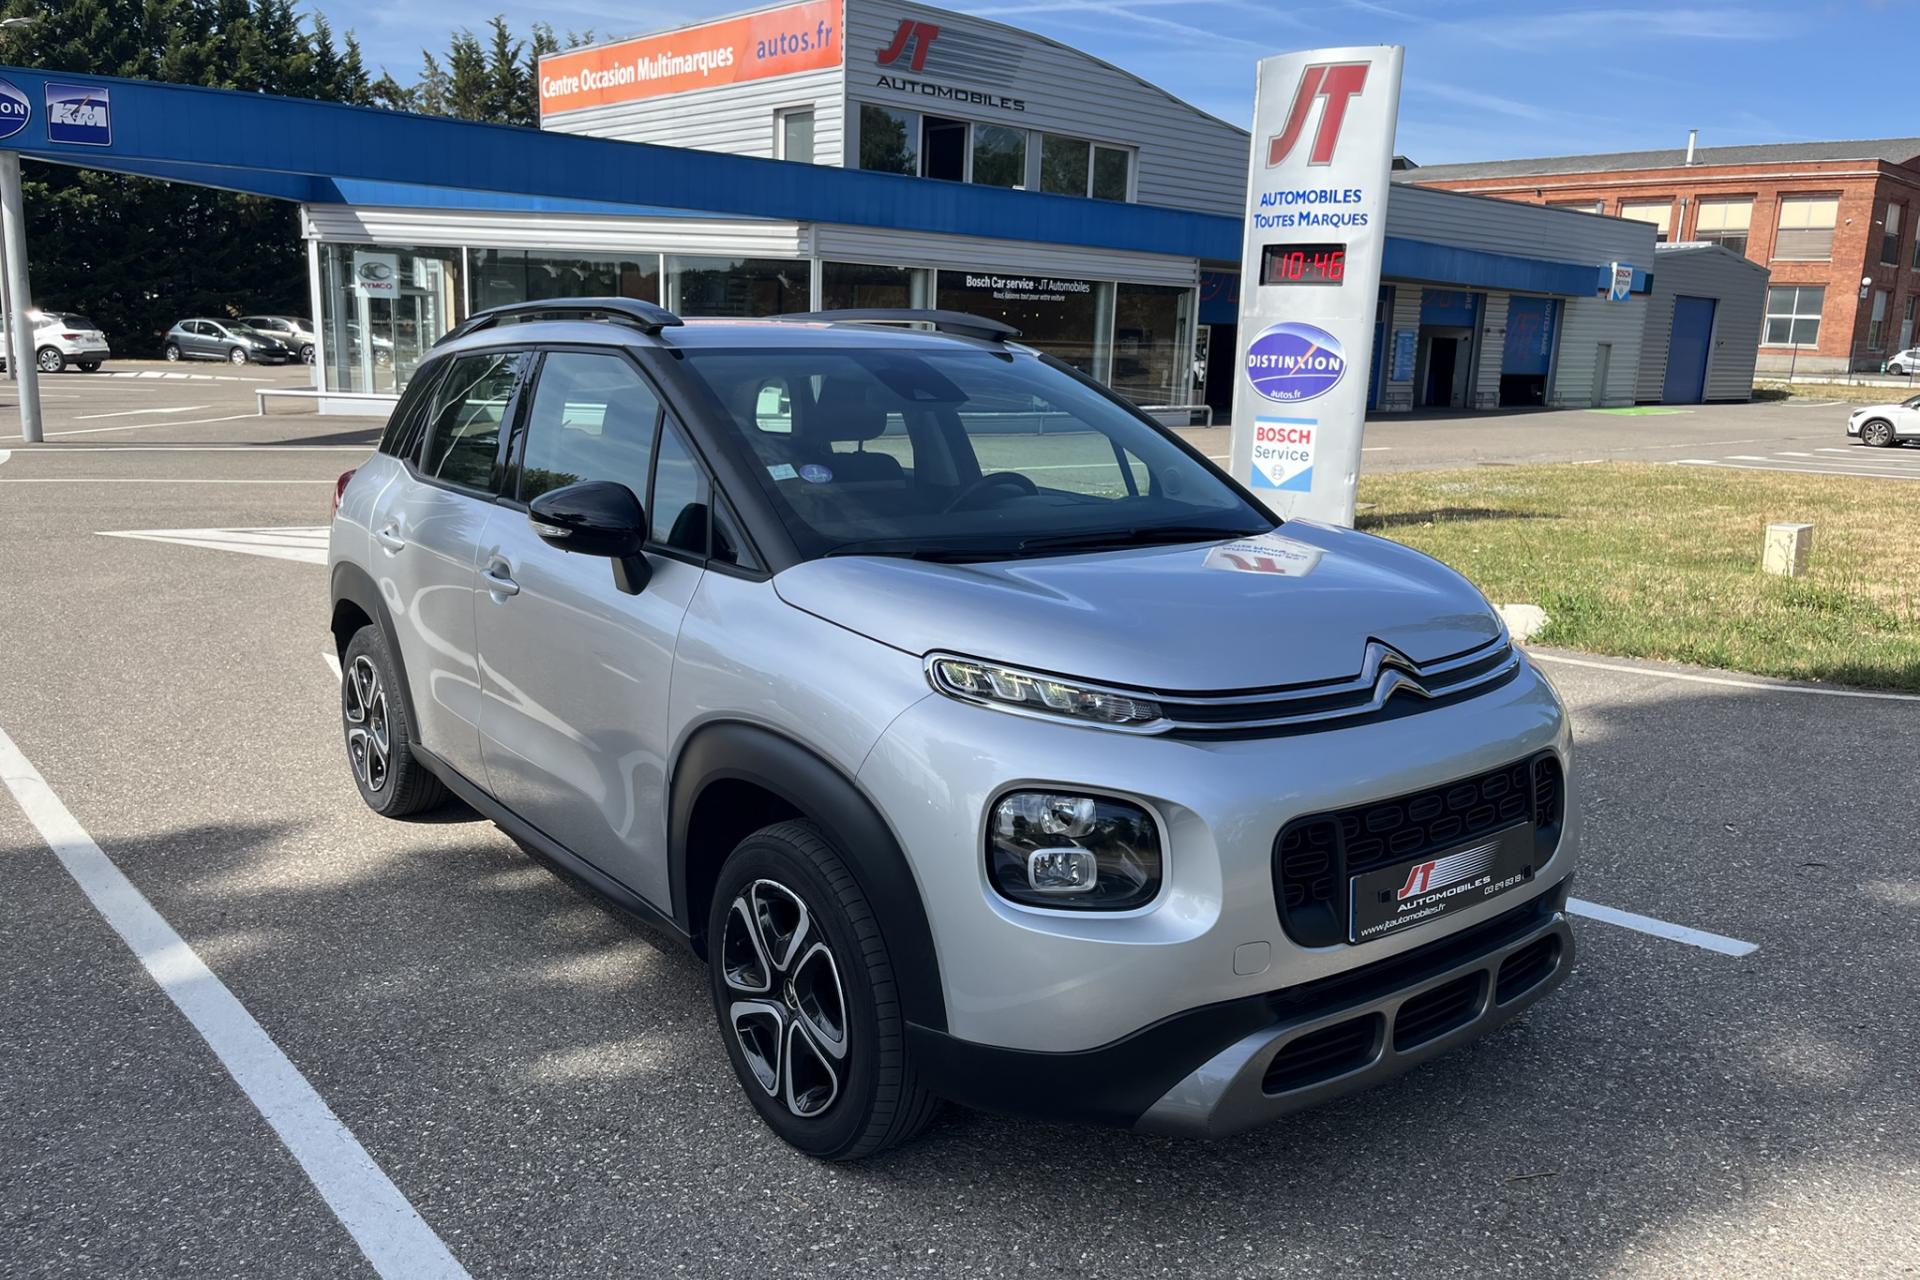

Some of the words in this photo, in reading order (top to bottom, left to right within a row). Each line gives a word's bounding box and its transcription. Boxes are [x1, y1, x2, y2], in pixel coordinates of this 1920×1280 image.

[756, 21, 832, 60] autos.fr
[877, 19, 941, 74] JT
[542, 75, 579, 98] Centre
[581, 64, 634, 92] Occasion
[637, 46, 734, 82] Multimarques
[876, 75, 1025, 112] AUTOMOBILES
[1265, 60, 1372, 169] JT
[1260, 189, 1362, 207] AUTOMOBILES
[1298, 211, 1368, 228] MARQUES
[1280, 251, 1344, 280] 10:46
[361, 282, 392, 290] KYMCO
[966, 275, 991, 288] Bosch
[991, 277, 1006, 289] Car
[1006, 278, 1034, 290] service
[1039, 279, 1048, 290] JT
[1048, 281, 1090, 293] Automobiles
[1248, 353, 1341, 371] DISTINXION
[1270, 389, 1301, 400] autos.fr
[1256, 427, 1311, 445] BOSCH
[1254, 445, 1310, 462] Service
[1397, 861, 1436, 900] JT
[1397, 875, 1491, 912] AUTOMOBILES
[1360, 903, 1446, 937] www.jtautomobiles.fr
